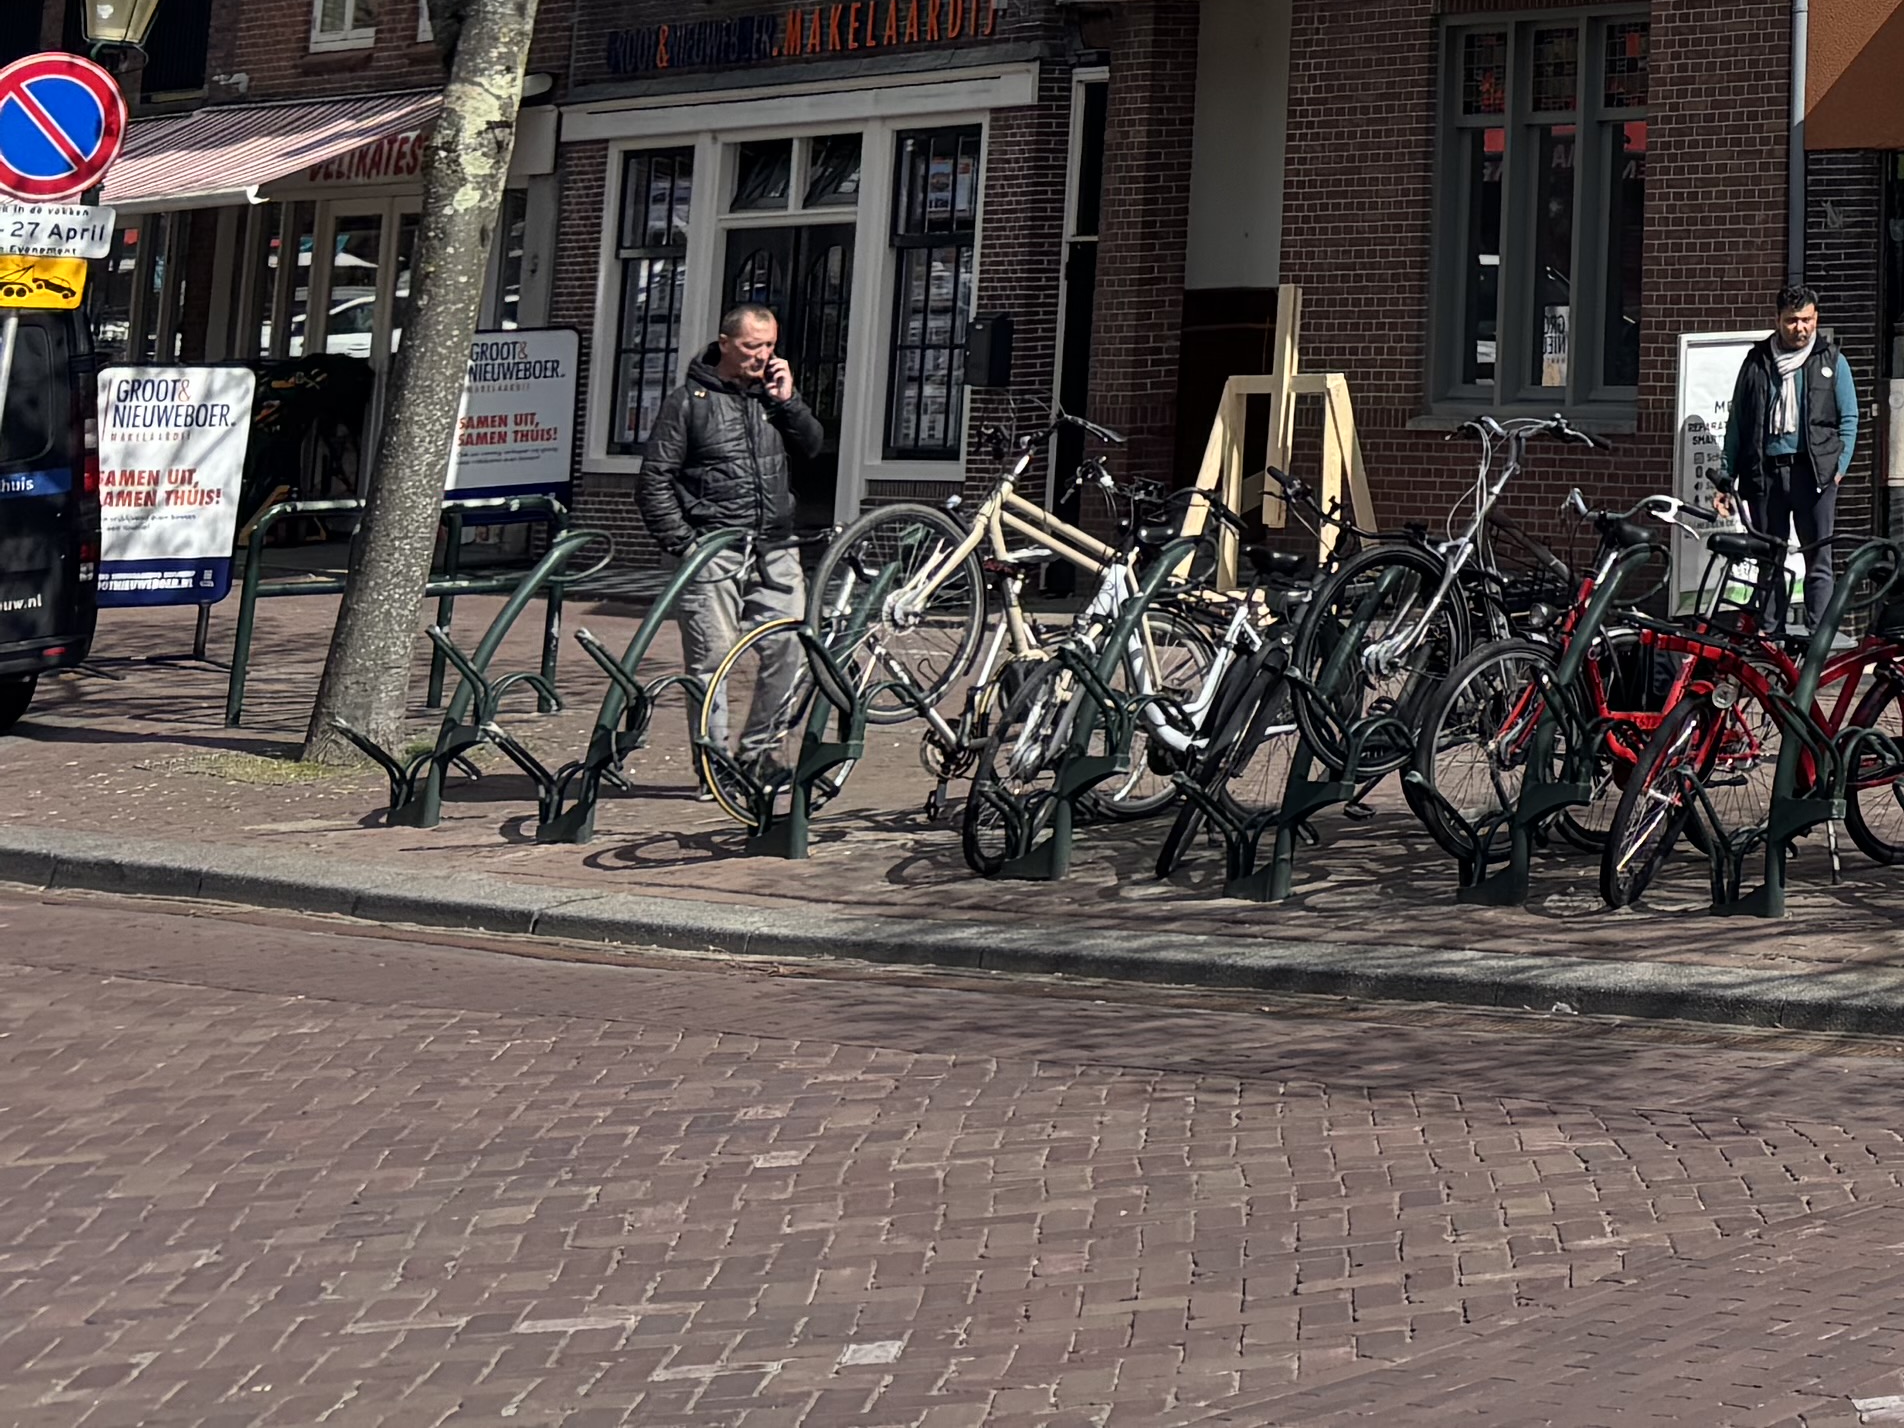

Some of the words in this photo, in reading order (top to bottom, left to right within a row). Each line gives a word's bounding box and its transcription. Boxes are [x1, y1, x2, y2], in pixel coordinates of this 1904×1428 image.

[309, 134, 427, 182] ELIKATES
[10, 221, 40, 238] 27
[47, 223, 105, 243] April
[470, 340, 529, 362] GROOT&
[468, 359, 566, 383] NIEUWEBOER.
[116, 378, 192, 403] GROOT&
[112, 403, 237, 429] NIEUWEBOER.
[459, 414, 508, 430] SAMEN
[513, 412, 540, 429] UIT,
[458, 430, 508, 447] SAMEN
[513, 427, 558, 444] THUIS!
[0, 475, 35, 493] huis
[167, 467, 200, 489] UIT,
[99, 489, 157, 508] AMEN
[164, 488, 222, 507] THUIS!
